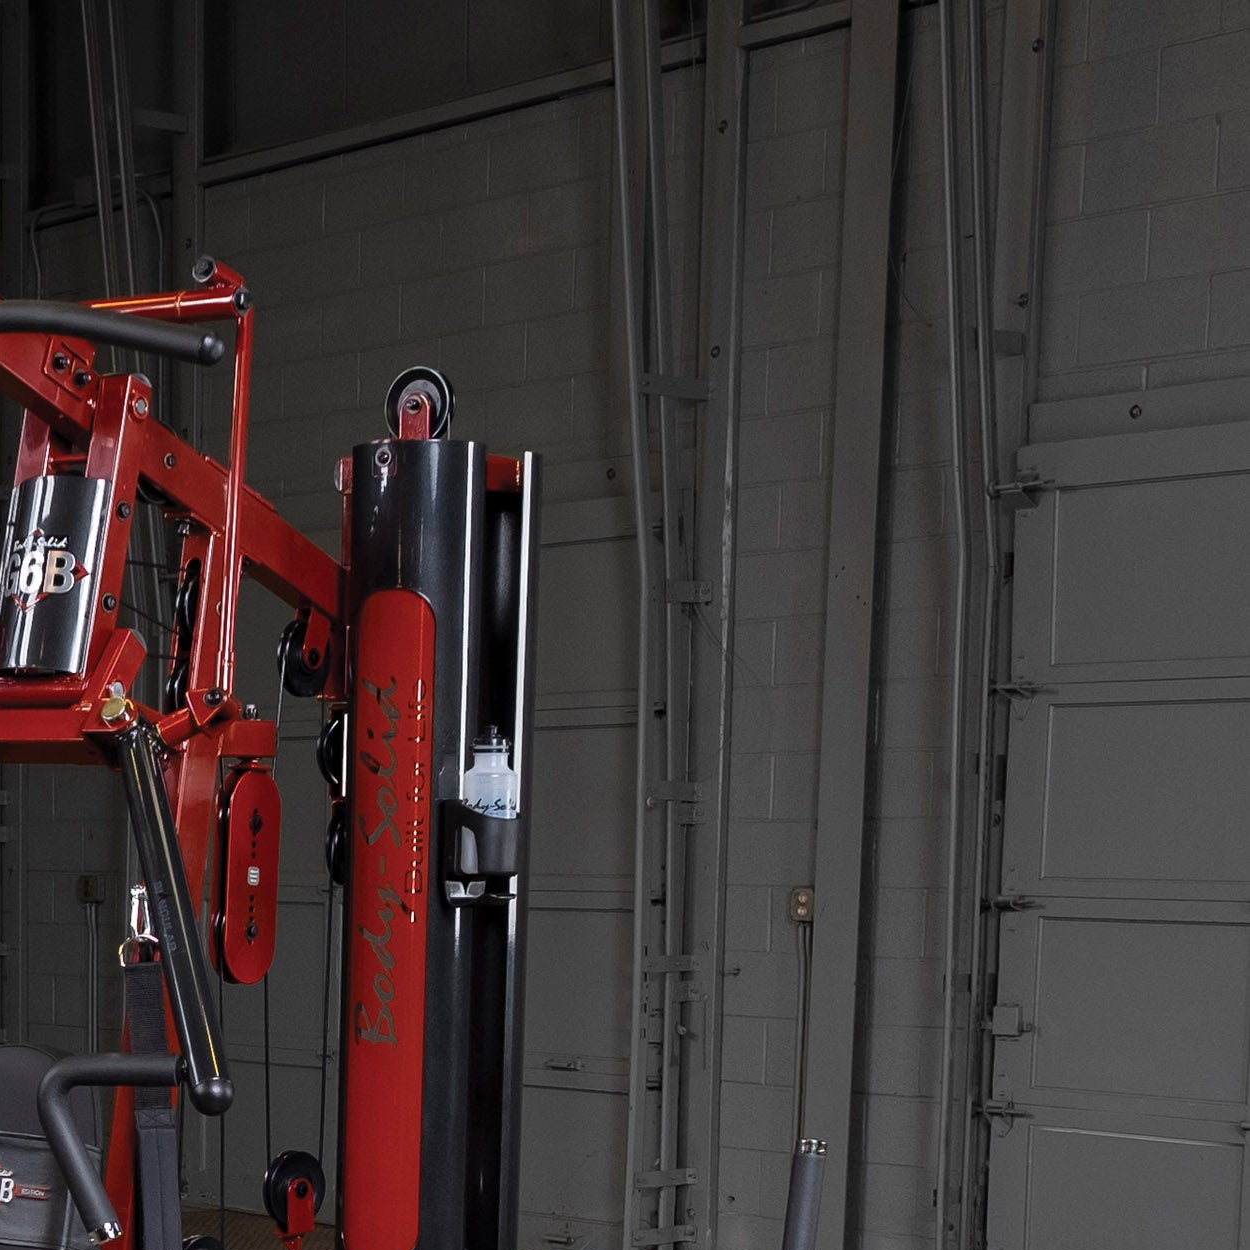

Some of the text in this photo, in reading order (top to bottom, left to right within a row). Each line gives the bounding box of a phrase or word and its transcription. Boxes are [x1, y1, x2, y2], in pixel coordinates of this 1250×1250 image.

[4, 550, 76, 597] G6B
[355, 676, 410, 1047] Body-Solid
[404, 678, 427, 894] Built for Life
